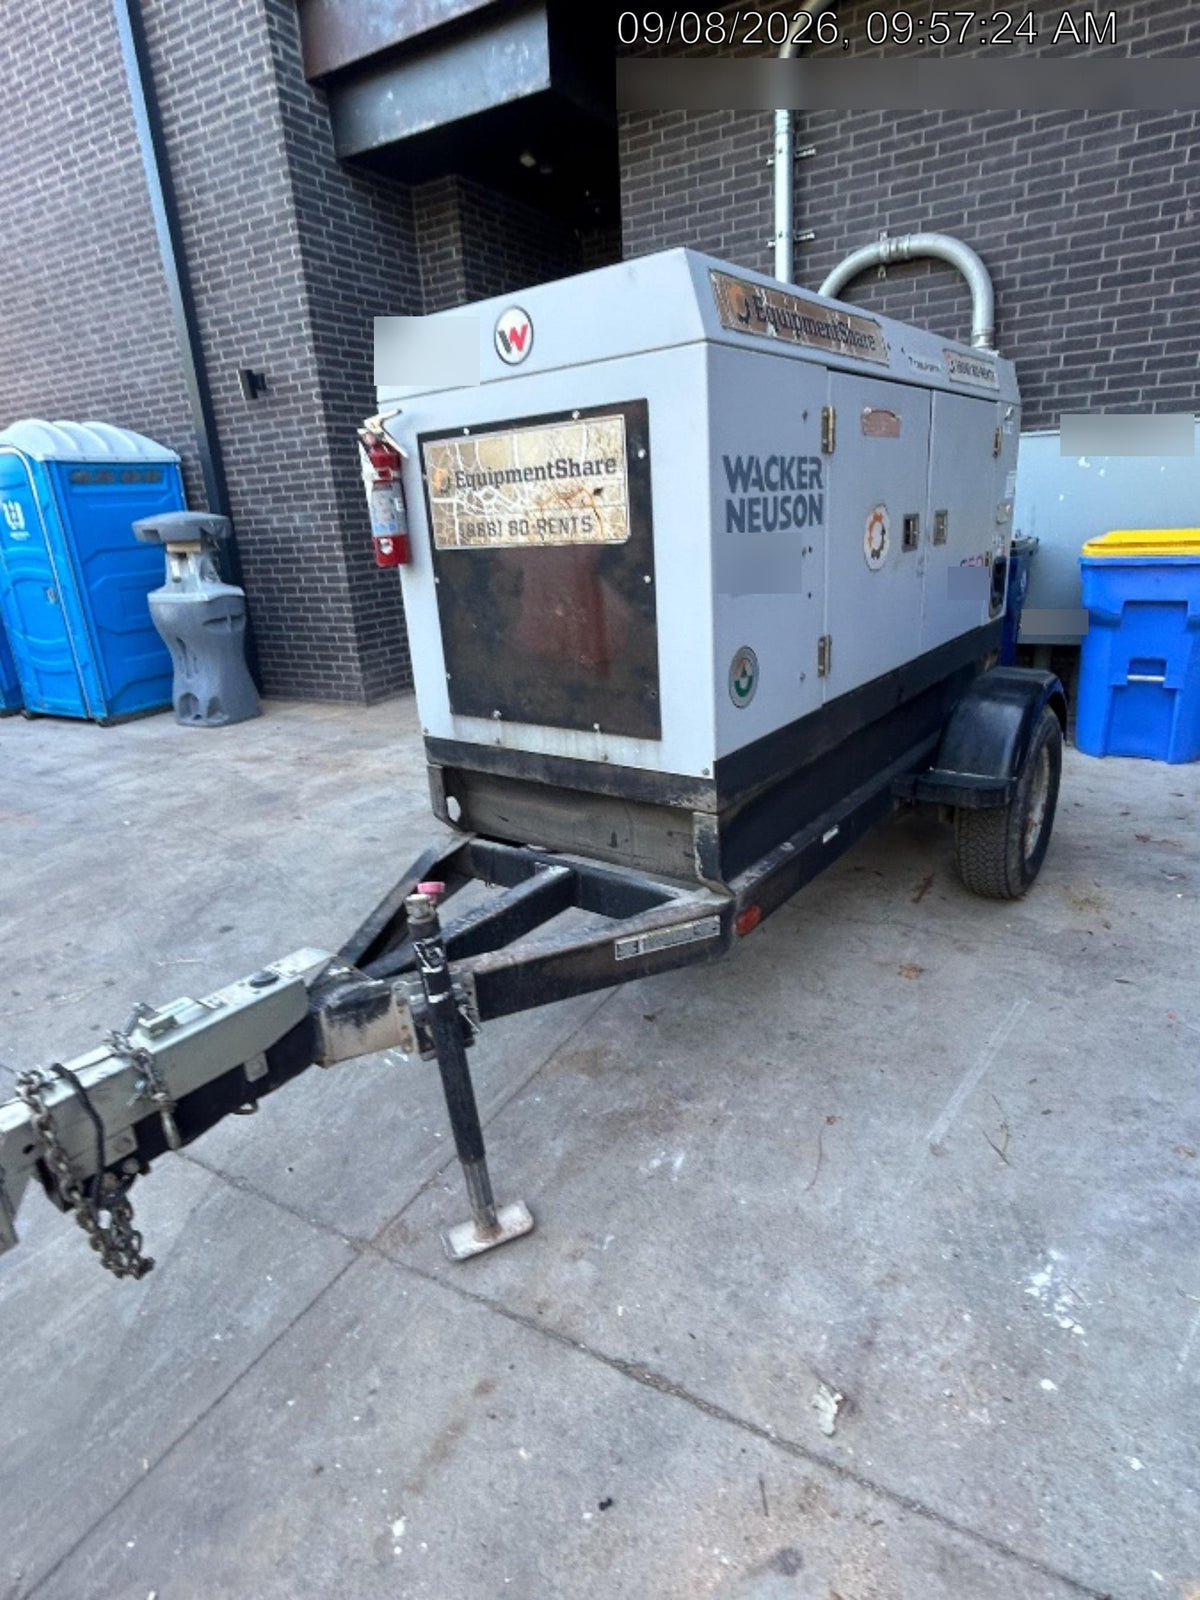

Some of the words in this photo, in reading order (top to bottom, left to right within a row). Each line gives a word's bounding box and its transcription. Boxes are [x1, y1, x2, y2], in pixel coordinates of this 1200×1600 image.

[497, 323, 529, 354] W
[752, 295, 876, 351] EquipmentShare
[455, 458, 617, 489] EquipmentShare
[722, 455, 823, 493] WACKER
[726, 494, 823, 533] NEUSON
